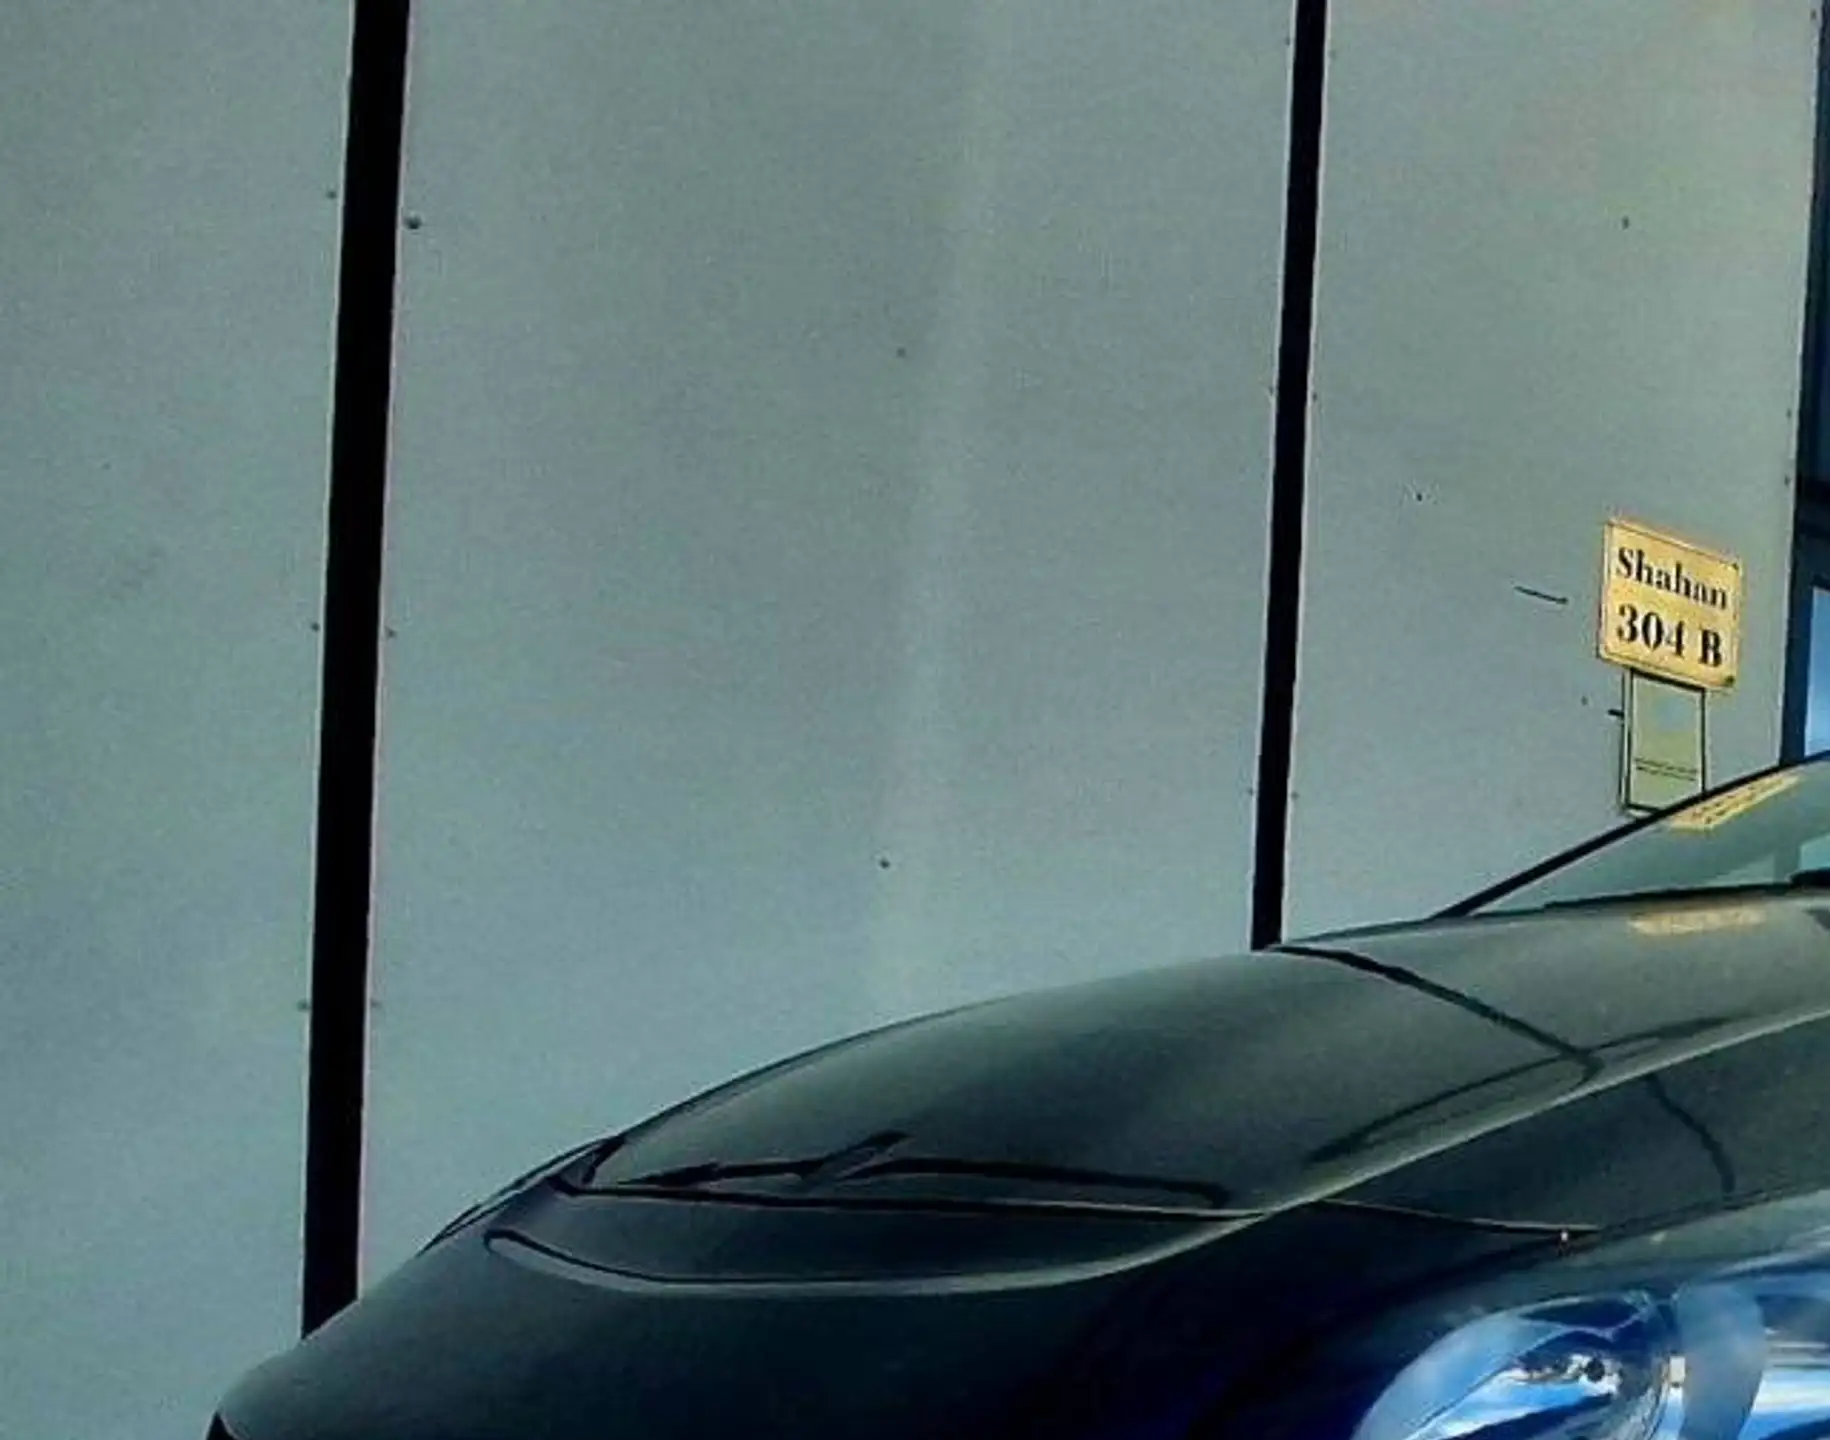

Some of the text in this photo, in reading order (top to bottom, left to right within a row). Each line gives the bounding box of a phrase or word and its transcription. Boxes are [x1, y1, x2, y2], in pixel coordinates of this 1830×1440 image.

[1616, 546, 1728, 610] Shahan
[1616, 602, 1724, 669] 304 B
